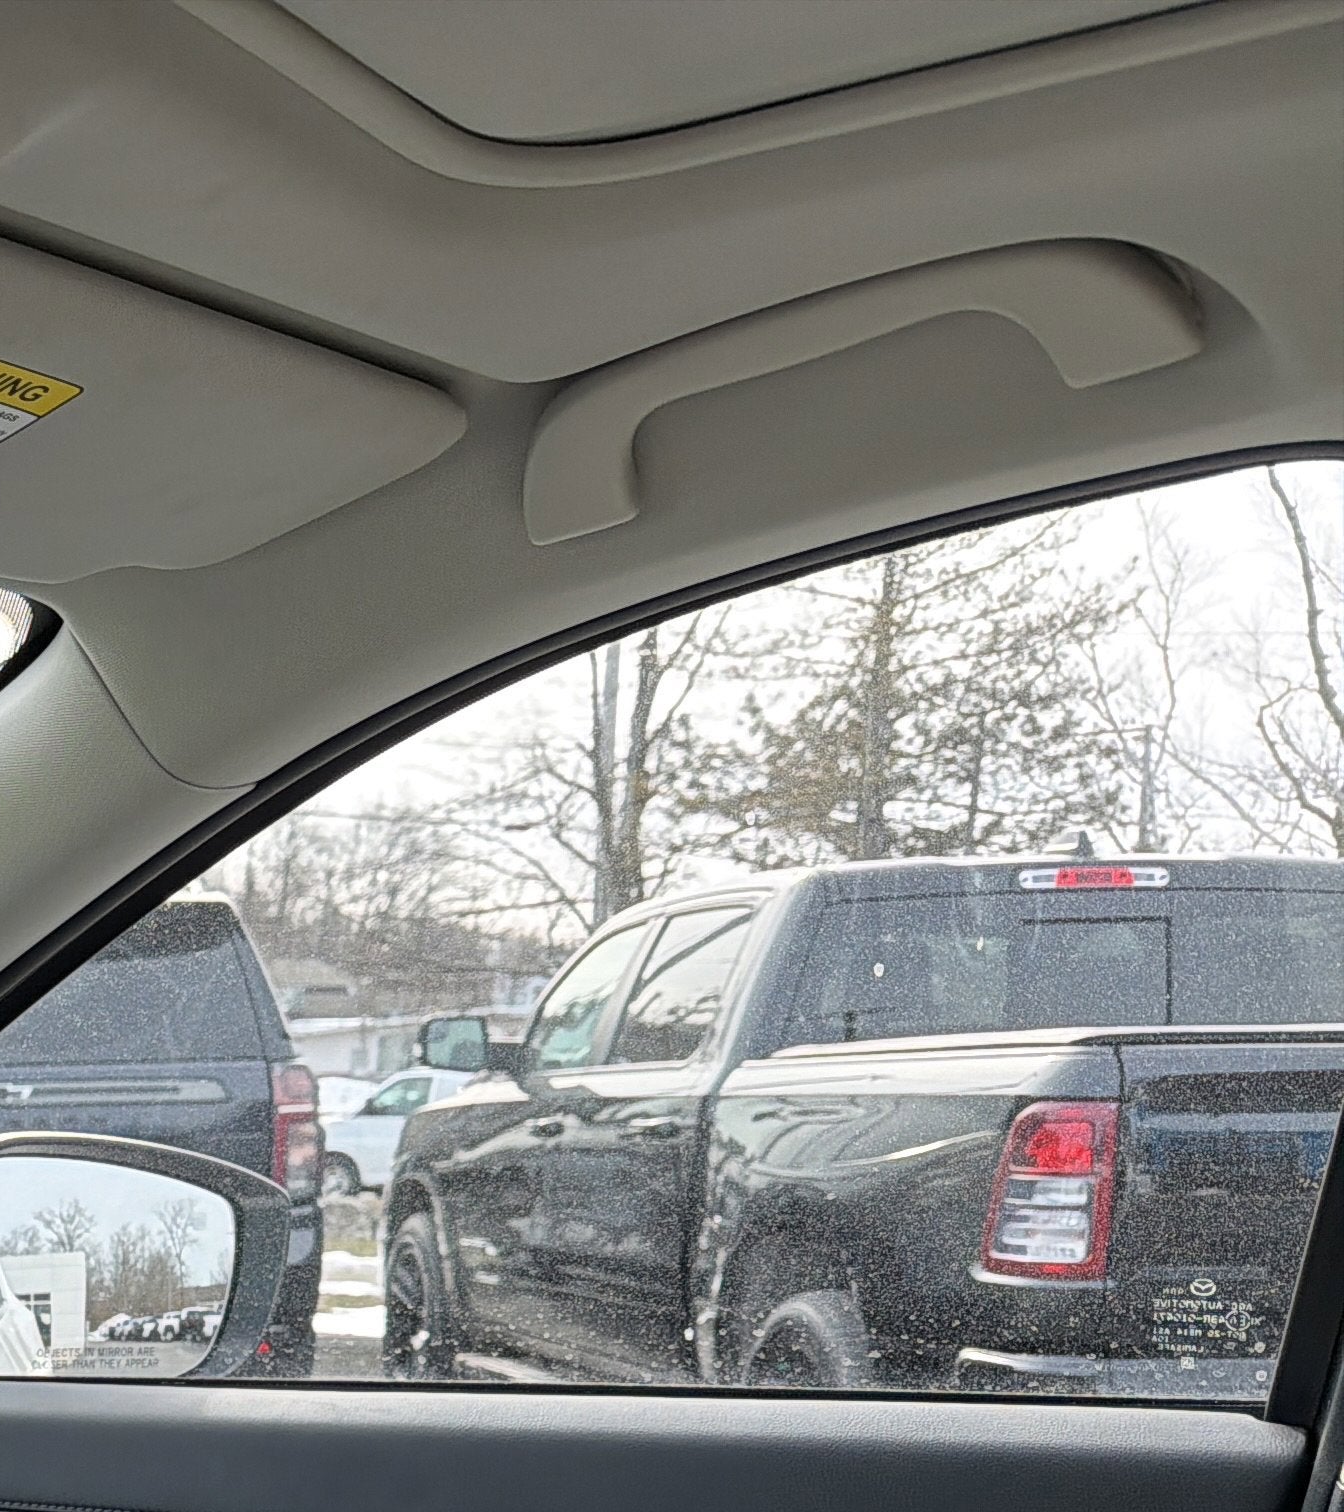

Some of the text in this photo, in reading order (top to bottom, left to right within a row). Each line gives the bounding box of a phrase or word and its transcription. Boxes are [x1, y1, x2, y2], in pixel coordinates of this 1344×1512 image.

[36, 1346, 156, 1358] OBJECTS IN MIRROR ARE
[72, 1360, 96, 1369] THAN
[99, 1359, 121, 1369] THEY
[124, 1358, 160, 1369] APPEAR
